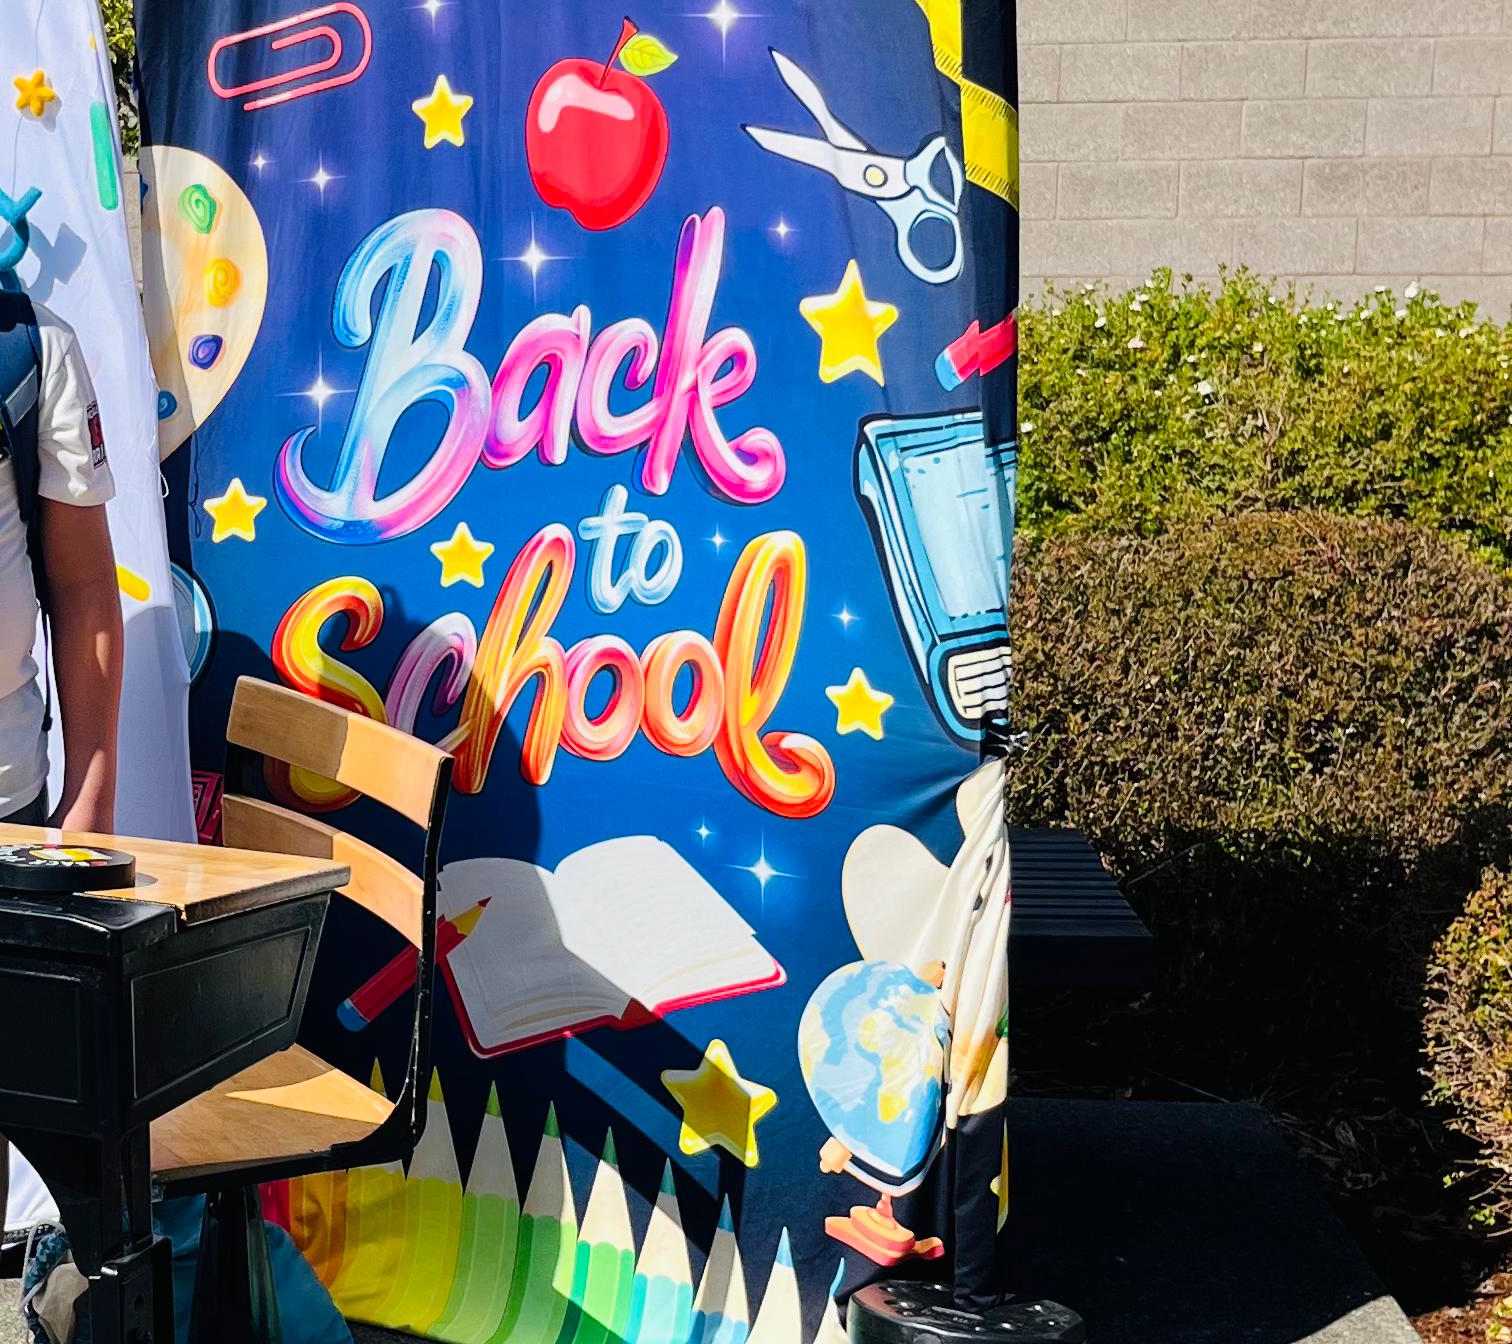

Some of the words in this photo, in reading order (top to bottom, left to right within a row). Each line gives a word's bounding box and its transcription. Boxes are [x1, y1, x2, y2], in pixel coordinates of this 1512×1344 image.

[273, 207, 787, 545] Back
[270, 523, 836, 819] School
[579, 484, 683, 613] to
